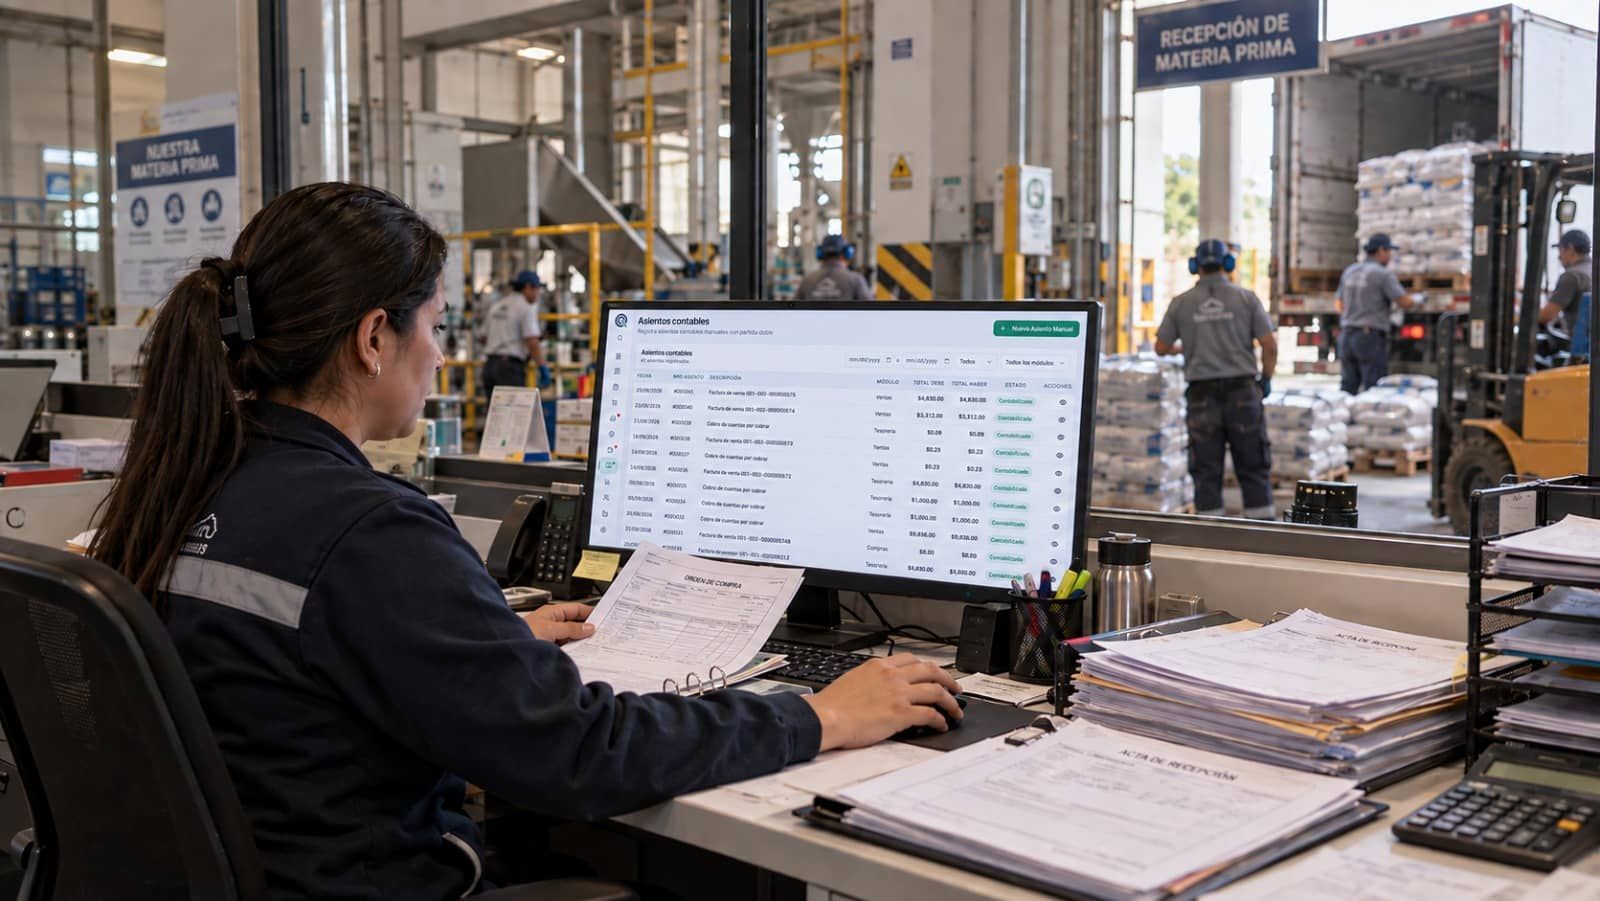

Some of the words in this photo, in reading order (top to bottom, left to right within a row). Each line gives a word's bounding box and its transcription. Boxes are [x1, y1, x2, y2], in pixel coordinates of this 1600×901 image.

[1161, 16, 1259, 49] RECEPCIÓN
[1264, 13, 1289, 34] DE
[1155, 46, 1231, 72] MATERIA
[1236, 37, 1296, 63] PRIMA
[146, 139, 200, 161] NUESTRA
[130, 160, 179, 180] MATERIA
[181, 154, 219, 175] PRIMA
[638, 317, 671, 326] Asientos
[672, 317, 710, 326] contables
[684, 574, 705, 584] ORDEN
[715, 580, 742, 589] COMPRA
[1120, 749, 1149, 760] ACTA
[1149, 756, 1165, 764] DE
[1168, 760, 1239, 781] RECEPCIÓN
